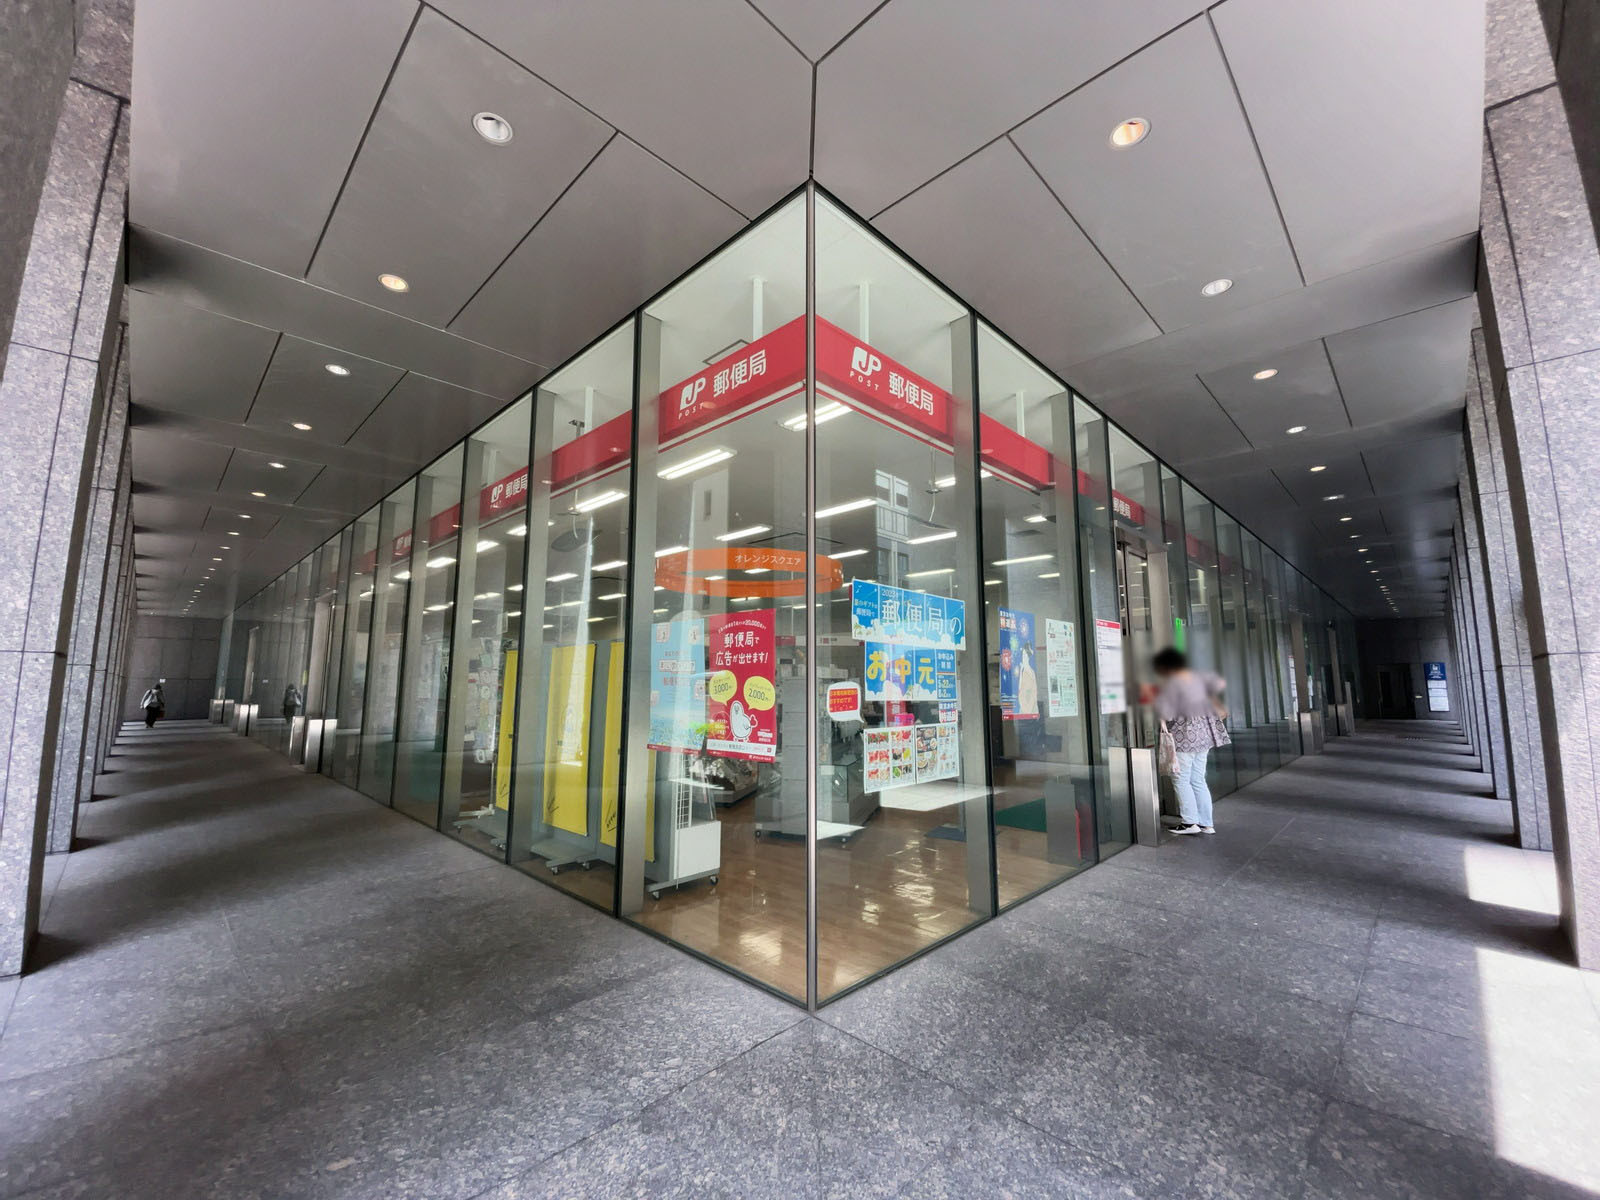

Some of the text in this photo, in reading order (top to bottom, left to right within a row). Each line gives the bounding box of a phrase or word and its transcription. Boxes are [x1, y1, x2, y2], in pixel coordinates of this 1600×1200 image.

[713, 349, 767, 398] 郵便局
[849, 370, 879, 391] POST
[889, 371, 934, 416] 郵便局
[678, 402, 704, 420] POST
[735, 554, 801, 566] オレンジスクエア
[881, 599, 962, 636] 郵便局の
[724, 631, 760, 648] 郵便局で
[867, 651, 935, 684] お中元
